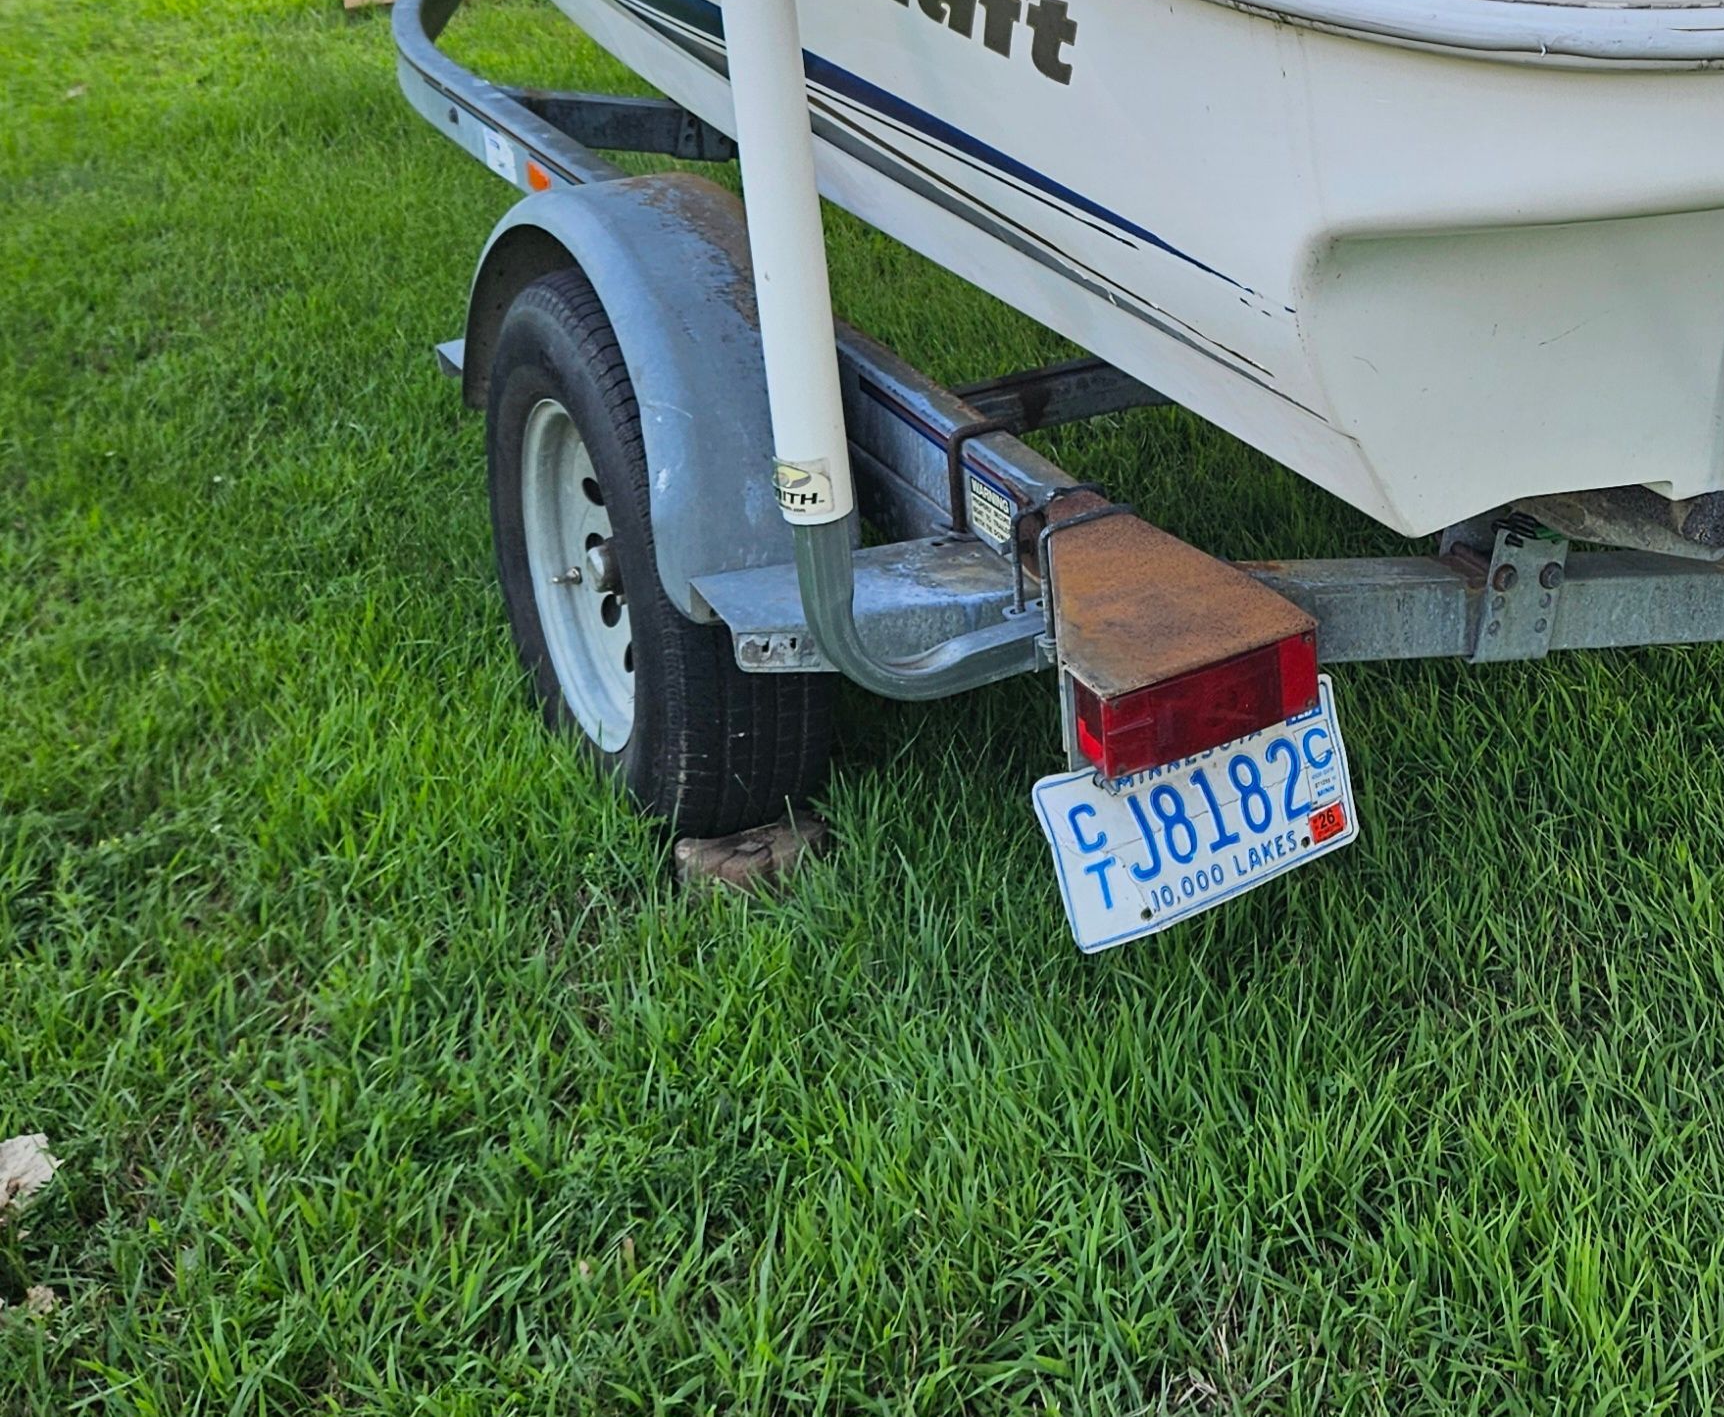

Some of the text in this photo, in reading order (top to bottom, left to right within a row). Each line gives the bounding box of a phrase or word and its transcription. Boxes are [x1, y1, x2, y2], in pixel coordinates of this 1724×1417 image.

[971, 477, 1010, 513] WARNING
[1127, 737, 1312, 882] J8182
[1319, 809, 1336, 829] 26
[1150, 830, 1298, 912] 10,000 LAKES
